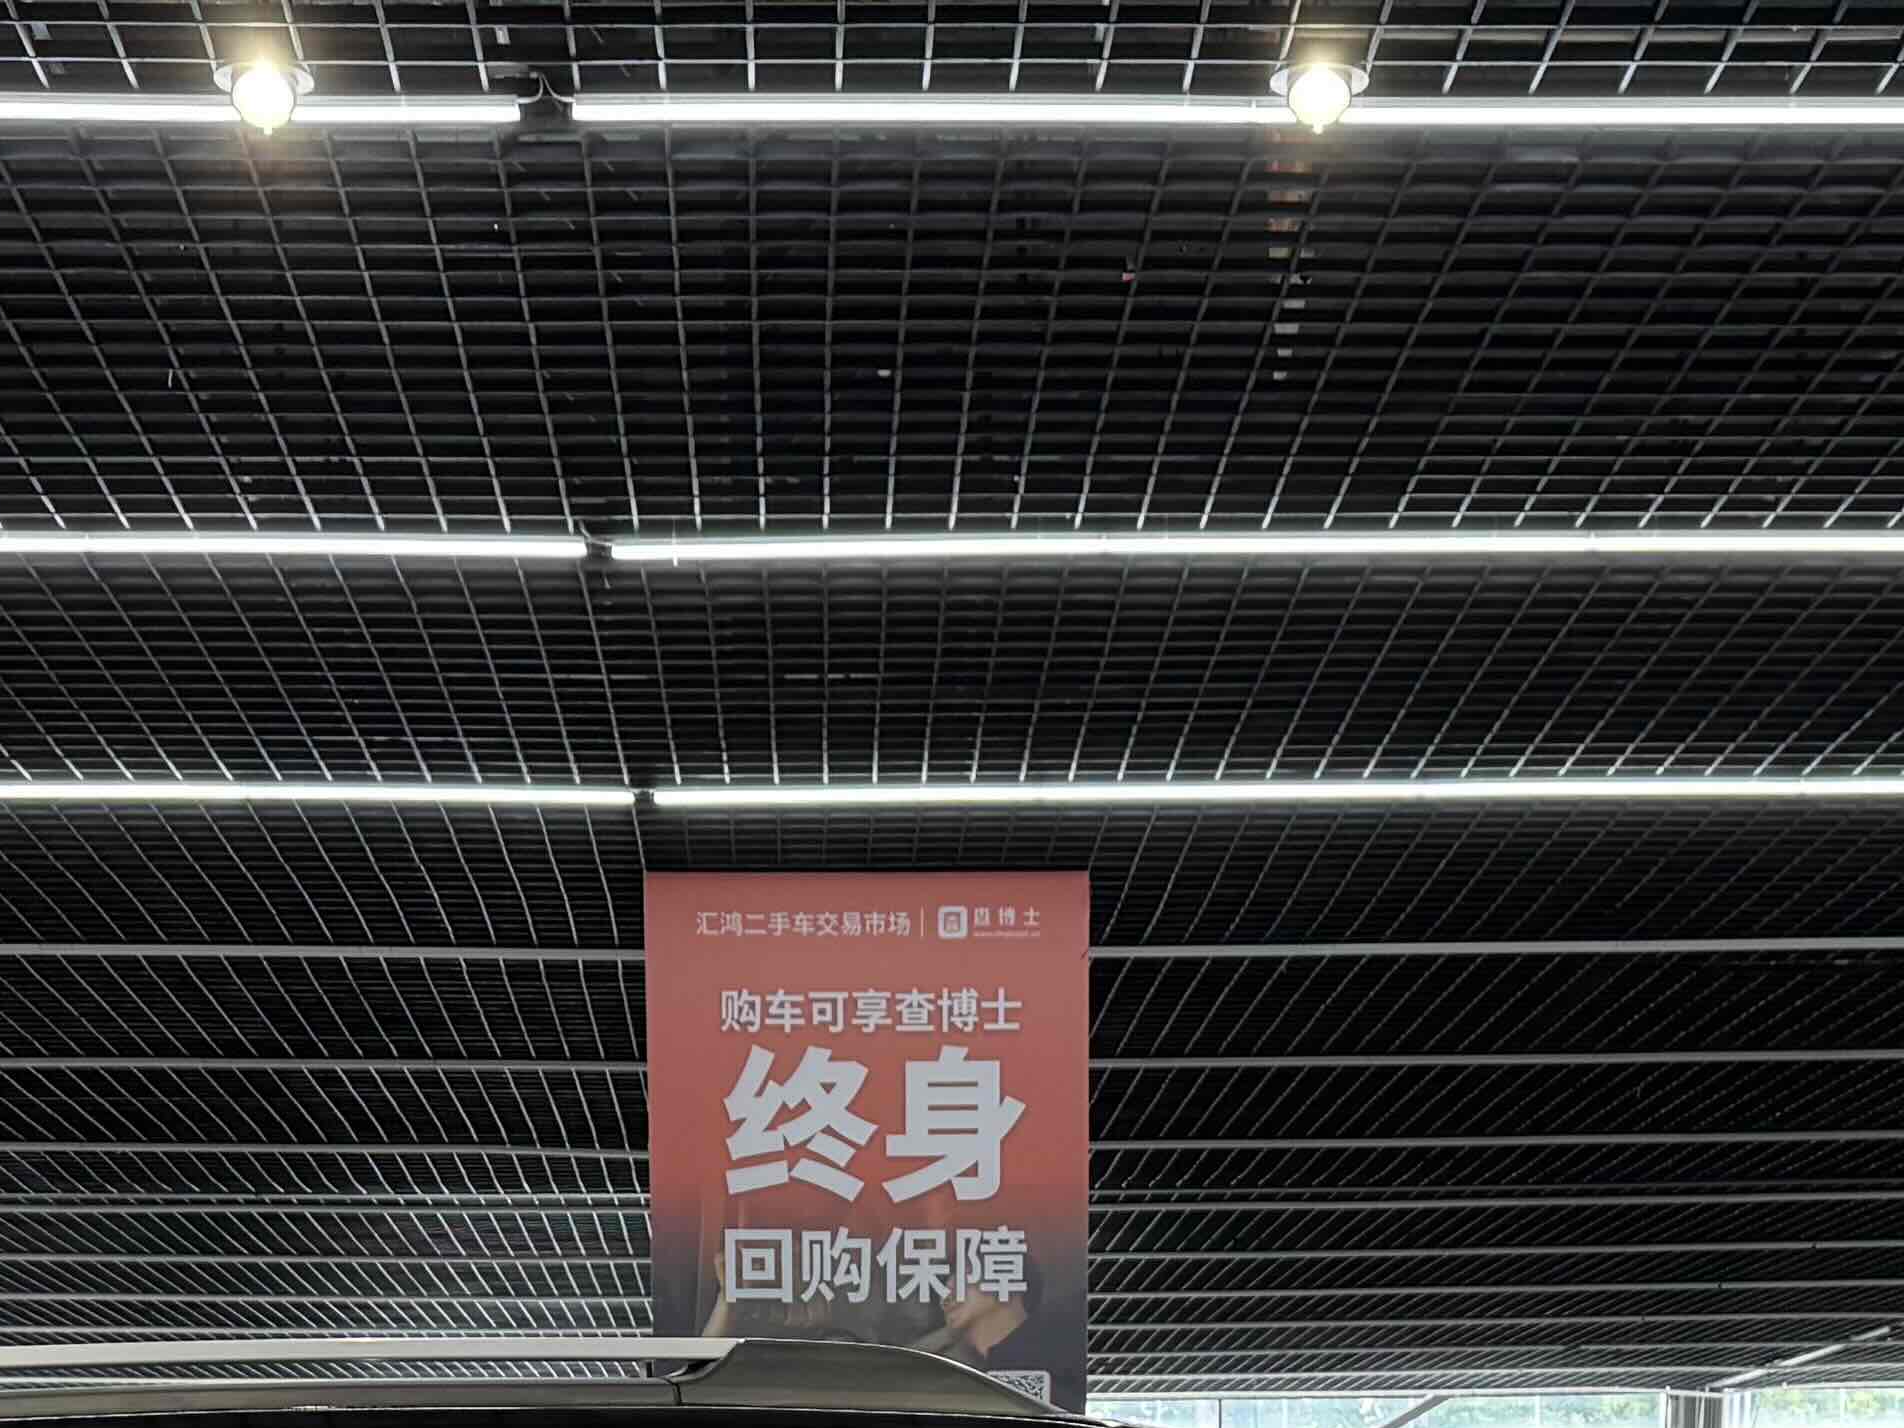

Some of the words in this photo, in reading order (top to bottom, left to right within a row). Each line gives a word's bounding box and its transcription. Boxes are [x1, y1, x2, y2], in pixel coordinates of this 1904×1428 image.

[696, 911, 911, 937] 汇鸿二手车交易市场
[720, 987, 1024, 1034] 购车可享查博士
[723, 1044, 1027, 1203] 终身
[722, 1225, 1029, 1303] 回购保障
